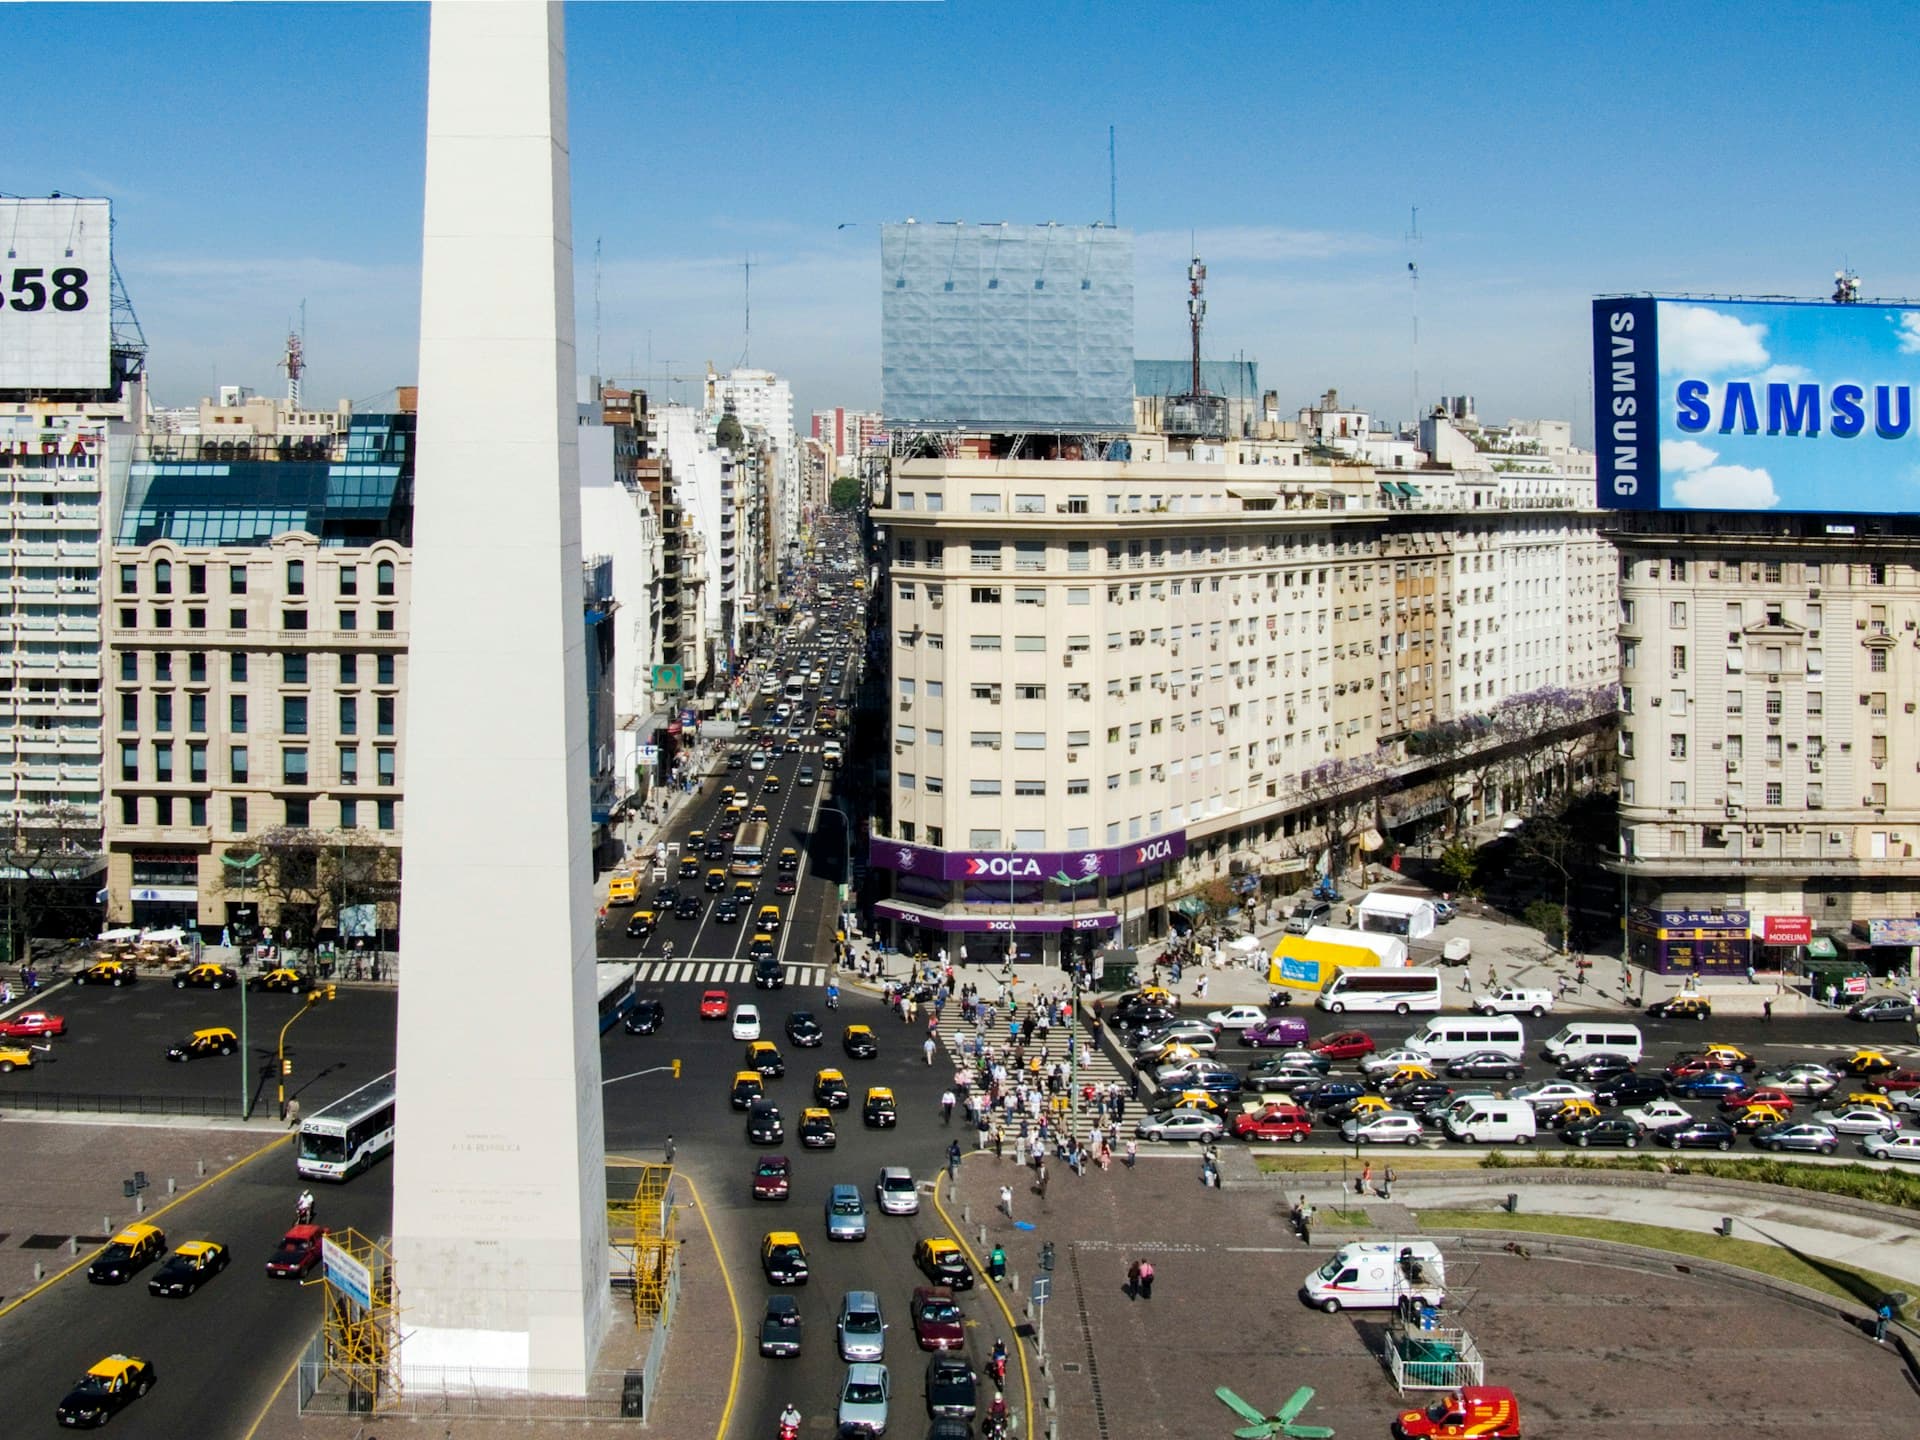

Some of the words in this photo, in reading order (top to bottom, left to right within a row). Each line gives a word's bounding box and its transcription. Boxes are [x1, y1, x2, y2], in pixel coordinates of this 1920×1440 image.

[0, 267, 88, 311] 58
[1610, 312, 1638, 496] SAMSUNG
[1147, 840, 1172, 860] OCA
[989, 857, 1042, 876] OCA
[905, 912, 920, 923] OCA
[995, 921, 1016, 930] OCA
[1081, 919, 1099, 928] OCA
[1768, 933, 1808, 942] MODELINA
[303, 1123, 320, 1132] 24
